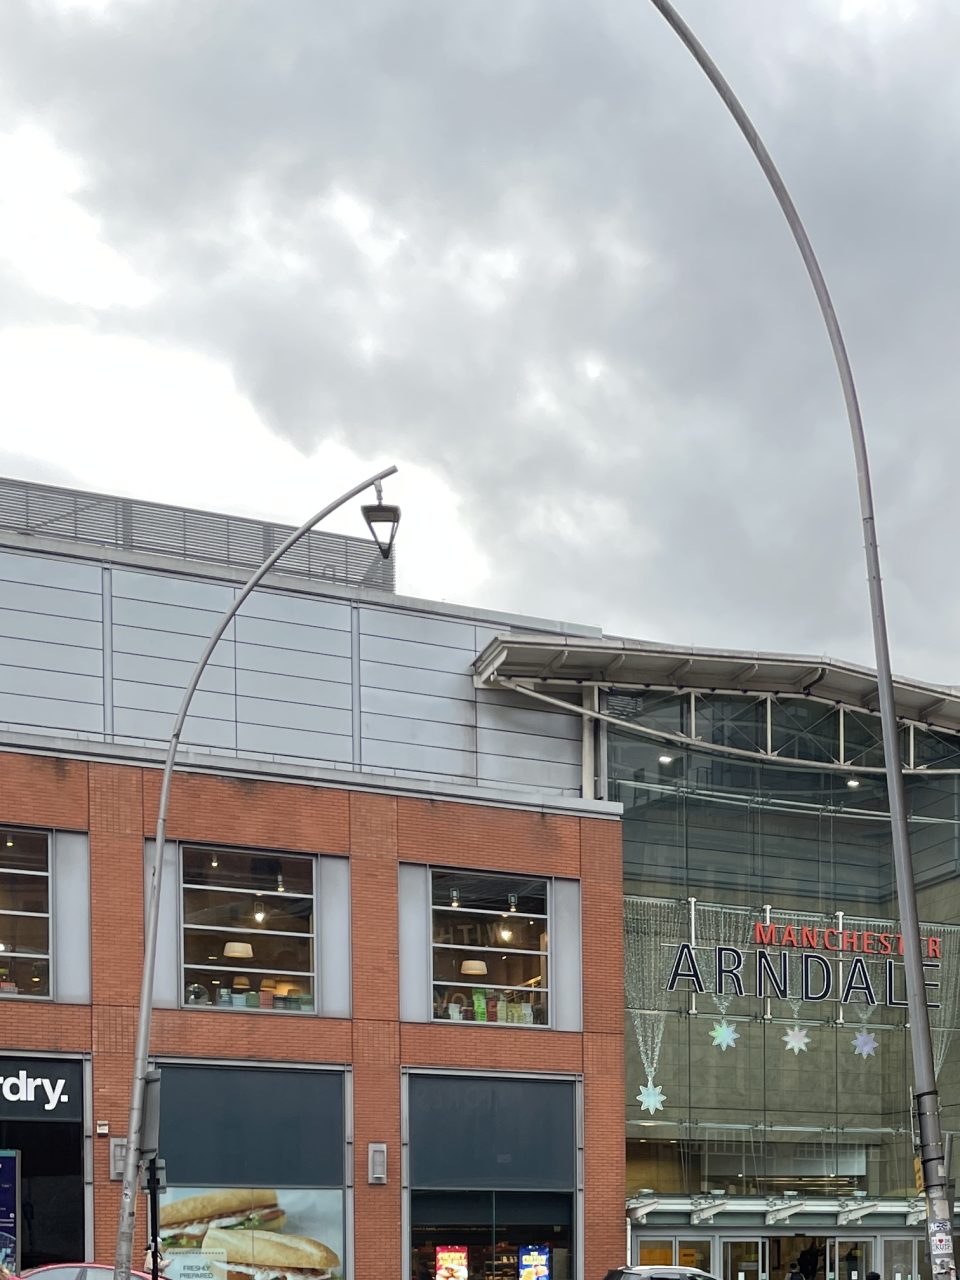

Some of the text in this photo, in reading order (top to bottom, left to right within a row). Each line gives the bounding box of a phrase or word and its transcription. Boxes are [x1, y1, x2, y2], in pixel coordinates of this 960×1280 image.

[755, 922, 942, 958] MANCHESTR
[667, 942, 941, 1010] ARNDALE
[0, 1070, 69, 1110] dry.
